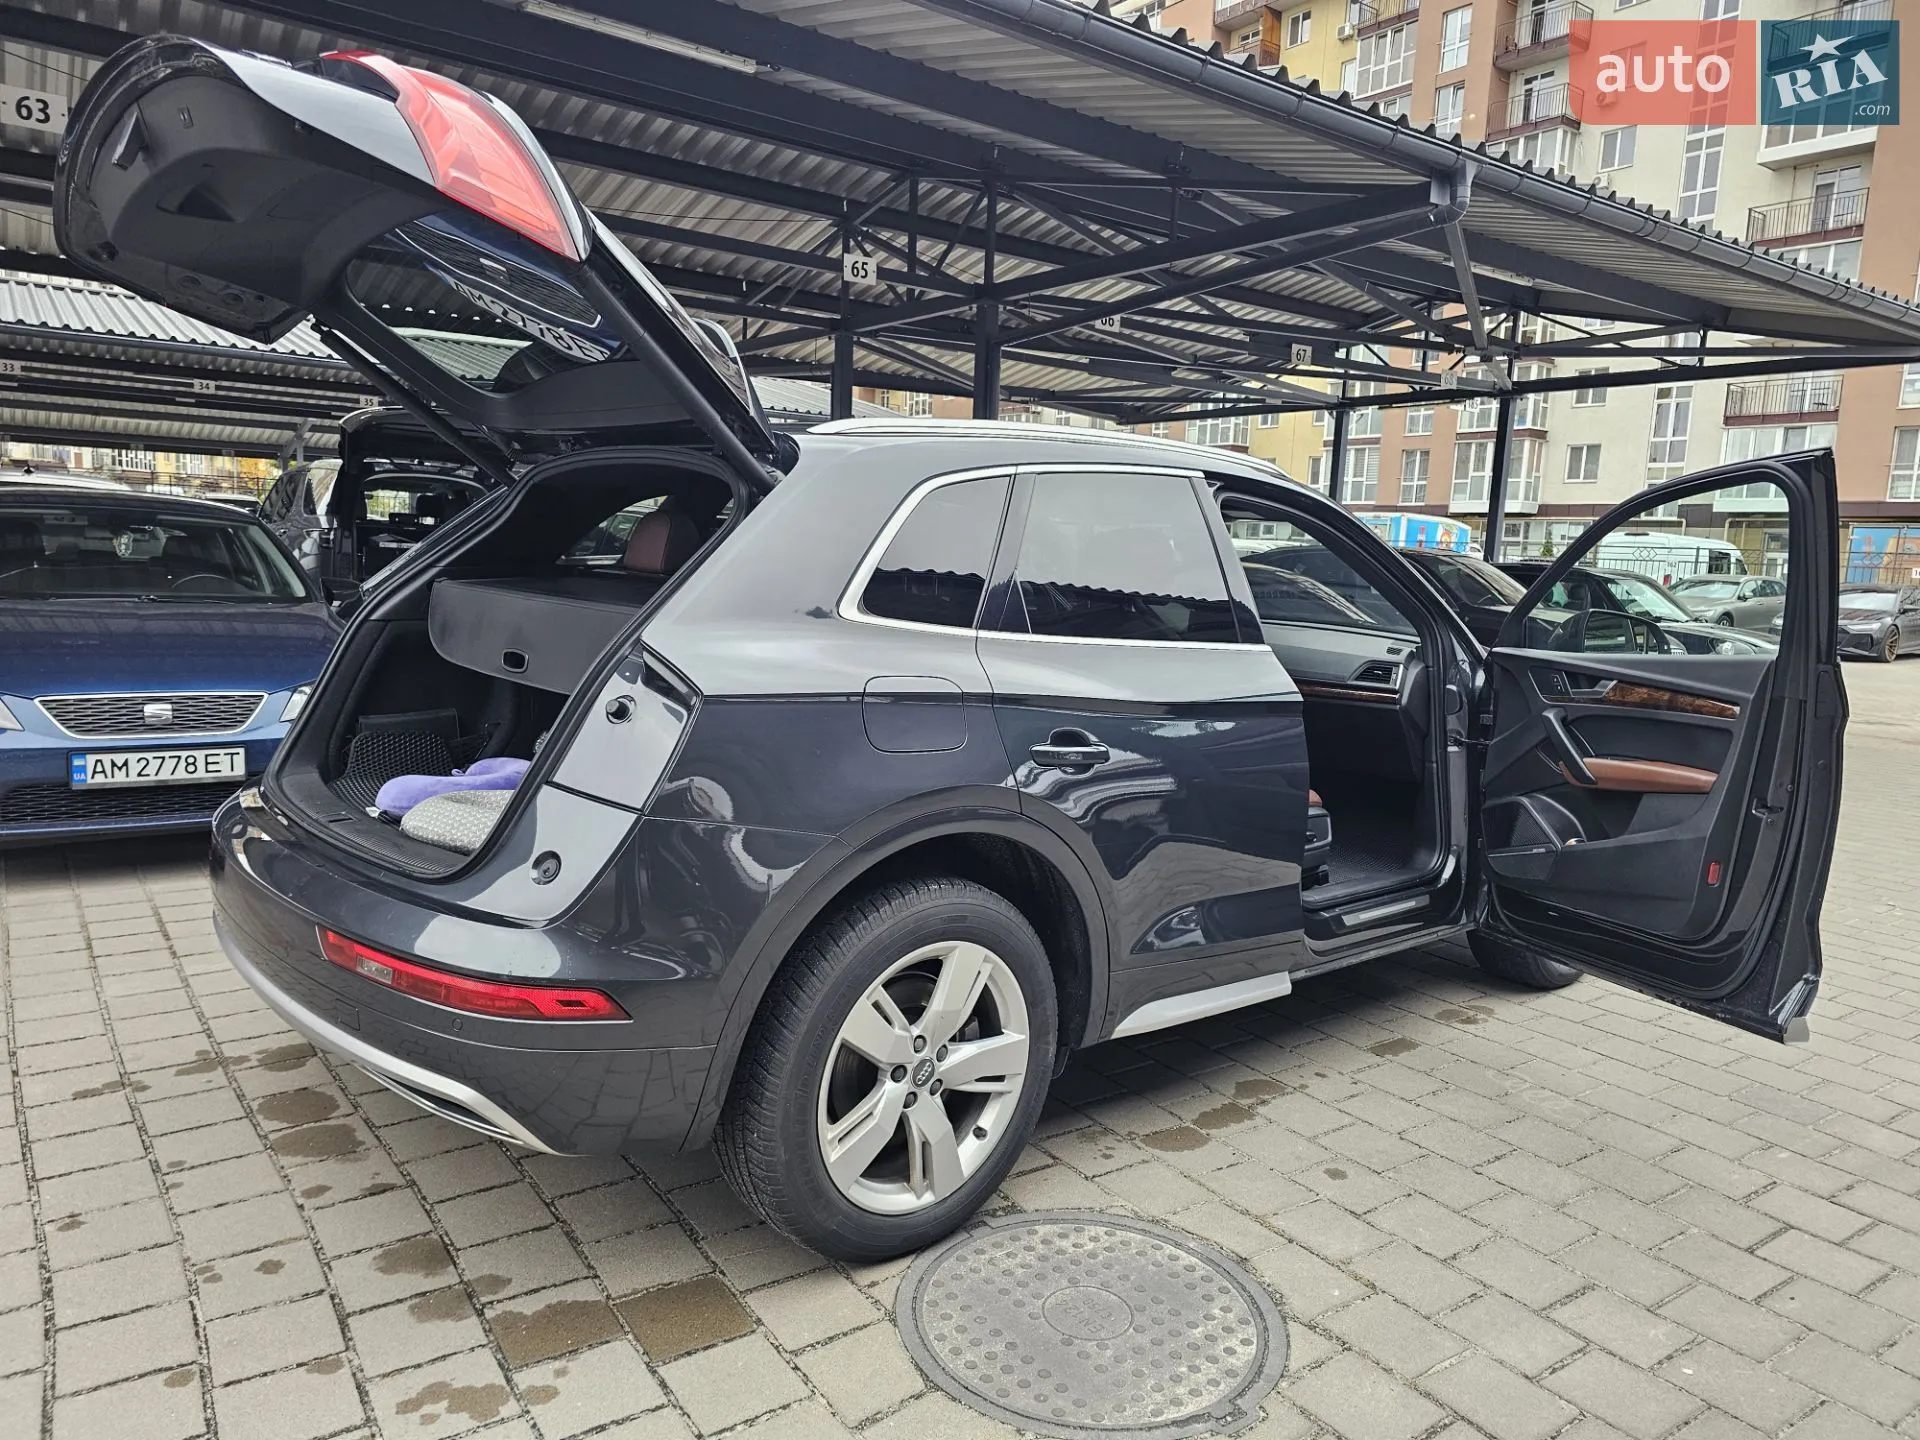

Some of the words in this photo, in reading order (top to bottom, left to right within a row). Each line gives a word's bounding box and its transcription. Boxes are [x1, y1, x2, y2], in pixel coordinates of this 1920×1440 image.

[15, 95, 51, 124] 63
[851, 260, 869, 279] 65
[1296, 347, 1307, 362] 67
[2, 362, 15, 373] 33
[198, 381, 211, 391] 34
[364, 397, 374, 407] 35
[90, 757, 130, 780] AM
[136, 754, 198, 778] 2778
[205, 752, 240, 774] ET
[73, 773, 86, 781] UA
